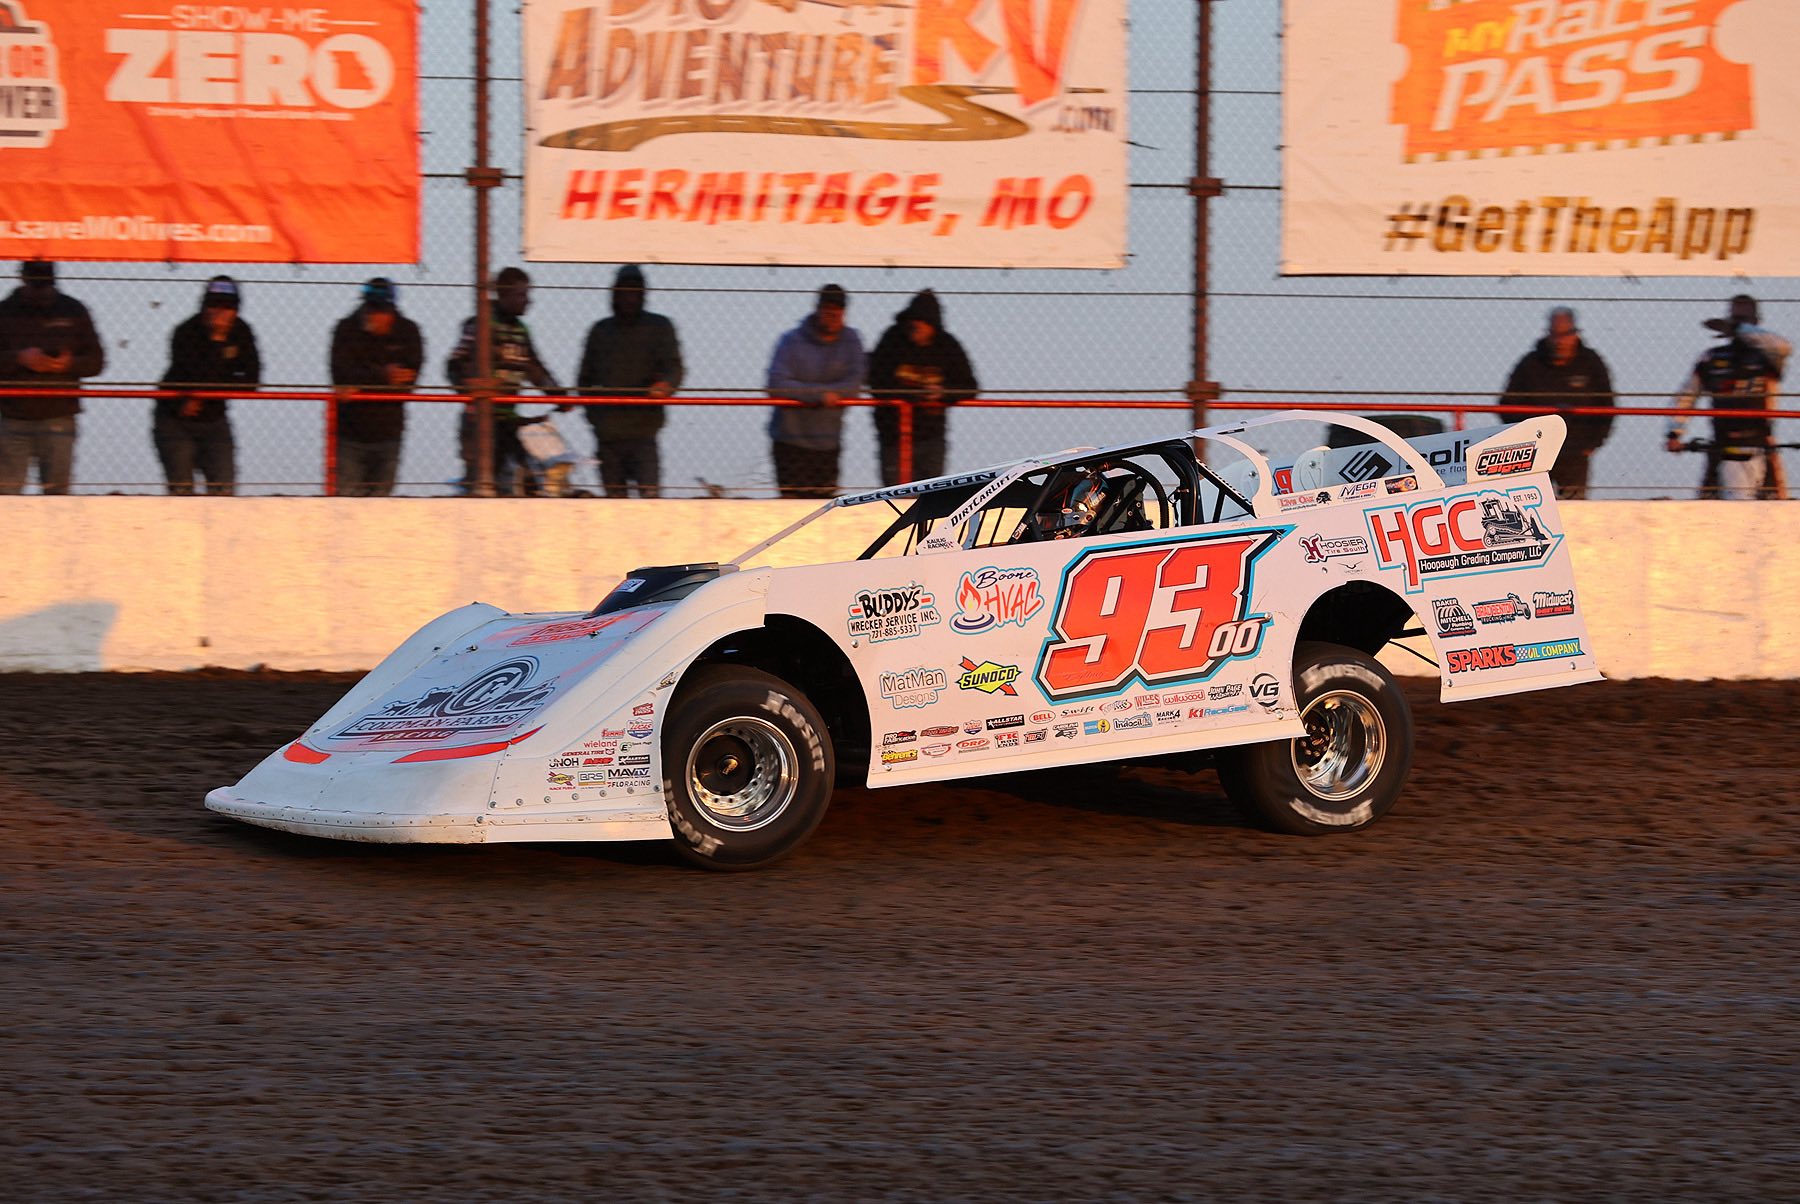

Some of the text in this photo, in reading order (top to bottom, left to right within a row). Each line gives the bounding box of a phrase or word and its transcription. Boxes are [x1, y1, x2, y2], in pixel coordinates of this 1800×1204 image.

[171, 4, 329, 33] SHOW-ME
[544, 7, 898, 103] ADVENTURE
[105, 28, 395, 109] ZERO
[1431, 25, 1708, 132] PASS
[560, 168, 1093, 236] HERMITAGE, MO
[1383, 194, 1755, 260] #GetTheApp
[1477, 448, 1532, 470] COLLINS
[1341, 482, 1377, 497] MEGA
[1321, 539, 1364, 549] HOOSIER
[1371, 500, 1486, 586] HGC
[1420, 546, 1542, 571] Hoopaugh Grading Company, LLC
[977, 571, 1034, 589] Boone
[859, 589, 921, 619] BUDDYS
[984, 582, 1041, 622] HVAC
[1436, 599, 1457, 607] BAKER
[1534, 592, 1573, 609] Midwest
[851, 610, 938, 632] WRECKER SERVICE INC.
[1042, 534, 1263, 696] 93 00
[1440, 615, 1472, 624] MITCHELL
[872, 624, 917, 639] 731-885-5331
[1446, 642, 1580, 673] SPARKS OIL COMPANY
[883, 671, 944, 692] MatMan
[962, 667, 1015, 687] SUNOCO
[895, 690, 936, 708] Designs
[1164, 691, 1204, 705] wilwood
[993, 716, 1022, 724] ALLSTAR
